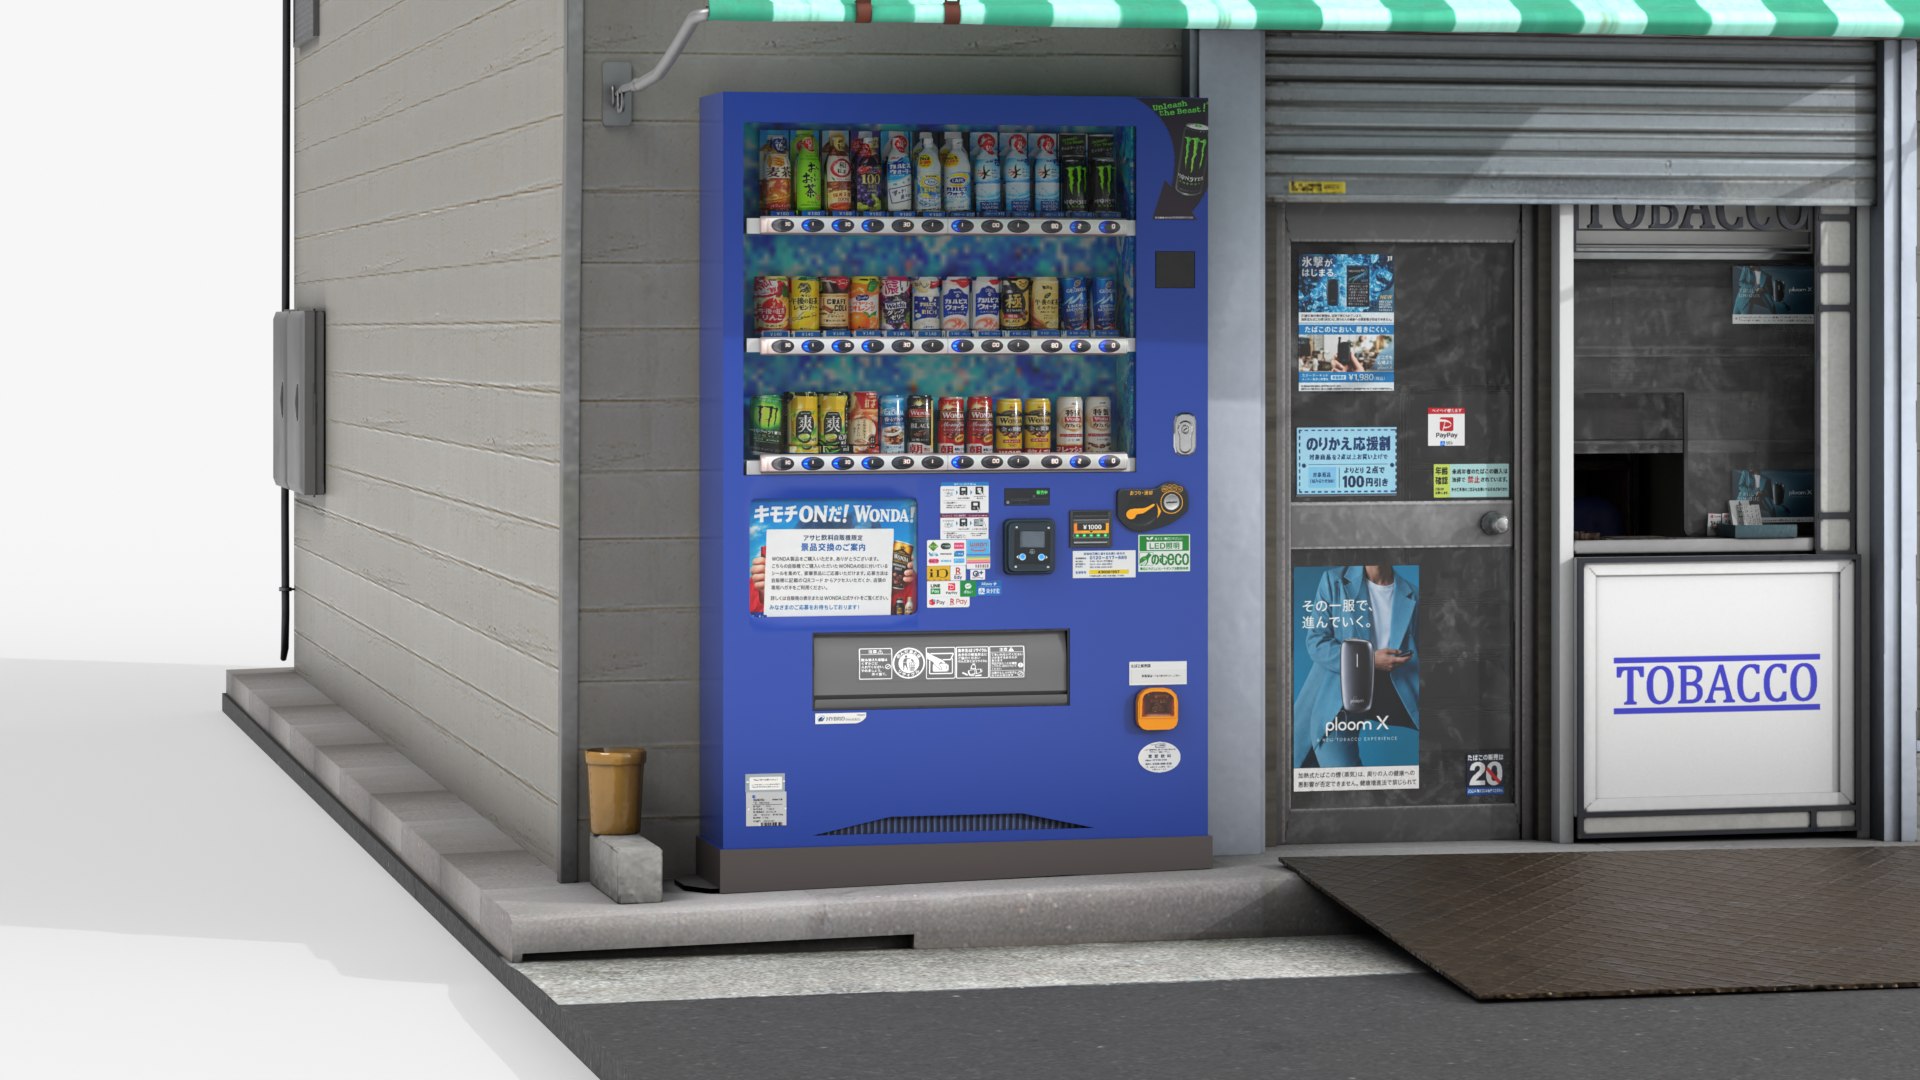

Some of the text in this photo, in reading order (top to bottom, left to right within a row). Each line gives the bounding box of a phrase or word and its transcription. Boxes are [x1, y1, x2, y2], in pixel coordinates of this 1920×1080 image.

[1152, 101, 1189, 112] Unleash
[1159, 108, 1176, 117] the
[767, 166, 791, 178] 麦茶
[861, 174, 880, 184] 100
[1301, 268, 1337, 277] はじまる。
[798, 415, 813, 433] 爽
[826, 415, 841, 433] 爽
[1435, 432, 1458, 440] PayPay
[1306, 435, 1391, 451] のりかえ応援割
[1342, 475, 1389, 488] 100円引き
[803, 534, 864, 542] アサヒ飲料自販機限定
[800, 543, 867, 552] 景品交換のご案内
[1149, 542, 1180, 550] LED照明
[1151, 553, 1189, 566] のむeco
[930, 568, 949, 578] iD
[1301, 599, 1374, 613] その一服で、
[1301, 615, 1373, 629] 進んでいく。
[1616, 663, 1818, 705] TOBACCO
[1325, 715, 1390, 737] ploom X
[1468, 761, 1503, 786] 20
